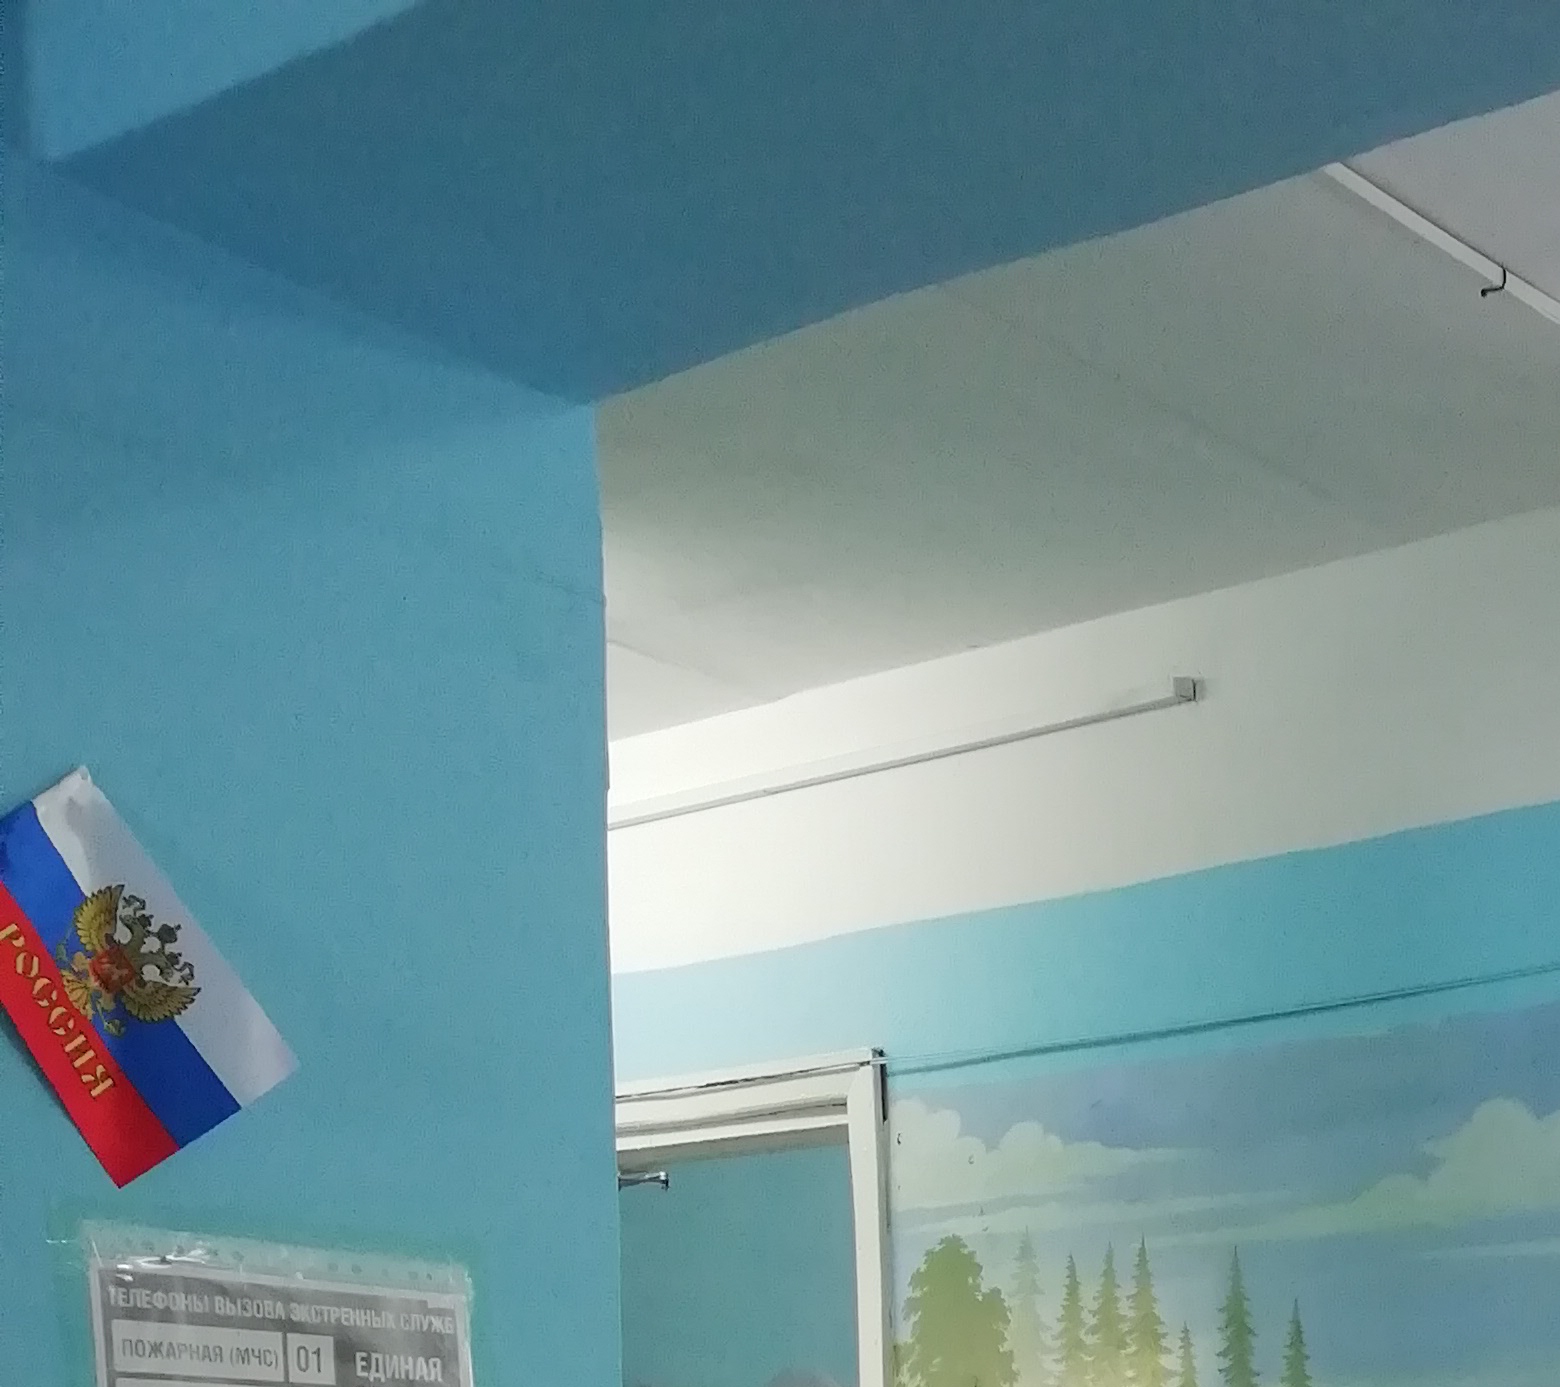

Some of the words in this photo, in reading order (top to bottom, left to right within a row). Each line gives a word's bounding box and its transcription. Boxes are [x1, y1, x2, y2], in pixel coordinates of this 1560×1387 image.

[0, 923, 117, 1099] РОССИЯ
[108, 1285, 209, 1313] ТЕЛЕФОНЫ
[214, 1296, 286, 1321] ВЫЗОВА
[289, 1302, 396, 1331] ЭКСТРЕННЫХ
[400, 1313, 455, 1334] СЛУЖБ
[121, 1338, 223, 1364] ПОЖАРНАЯ
[229, 1347, 279, 1370] (МЧС)
[296, 1345, 322, 1373] 01
[355, 1351, 442, 1383] ЕДИНАЯ
